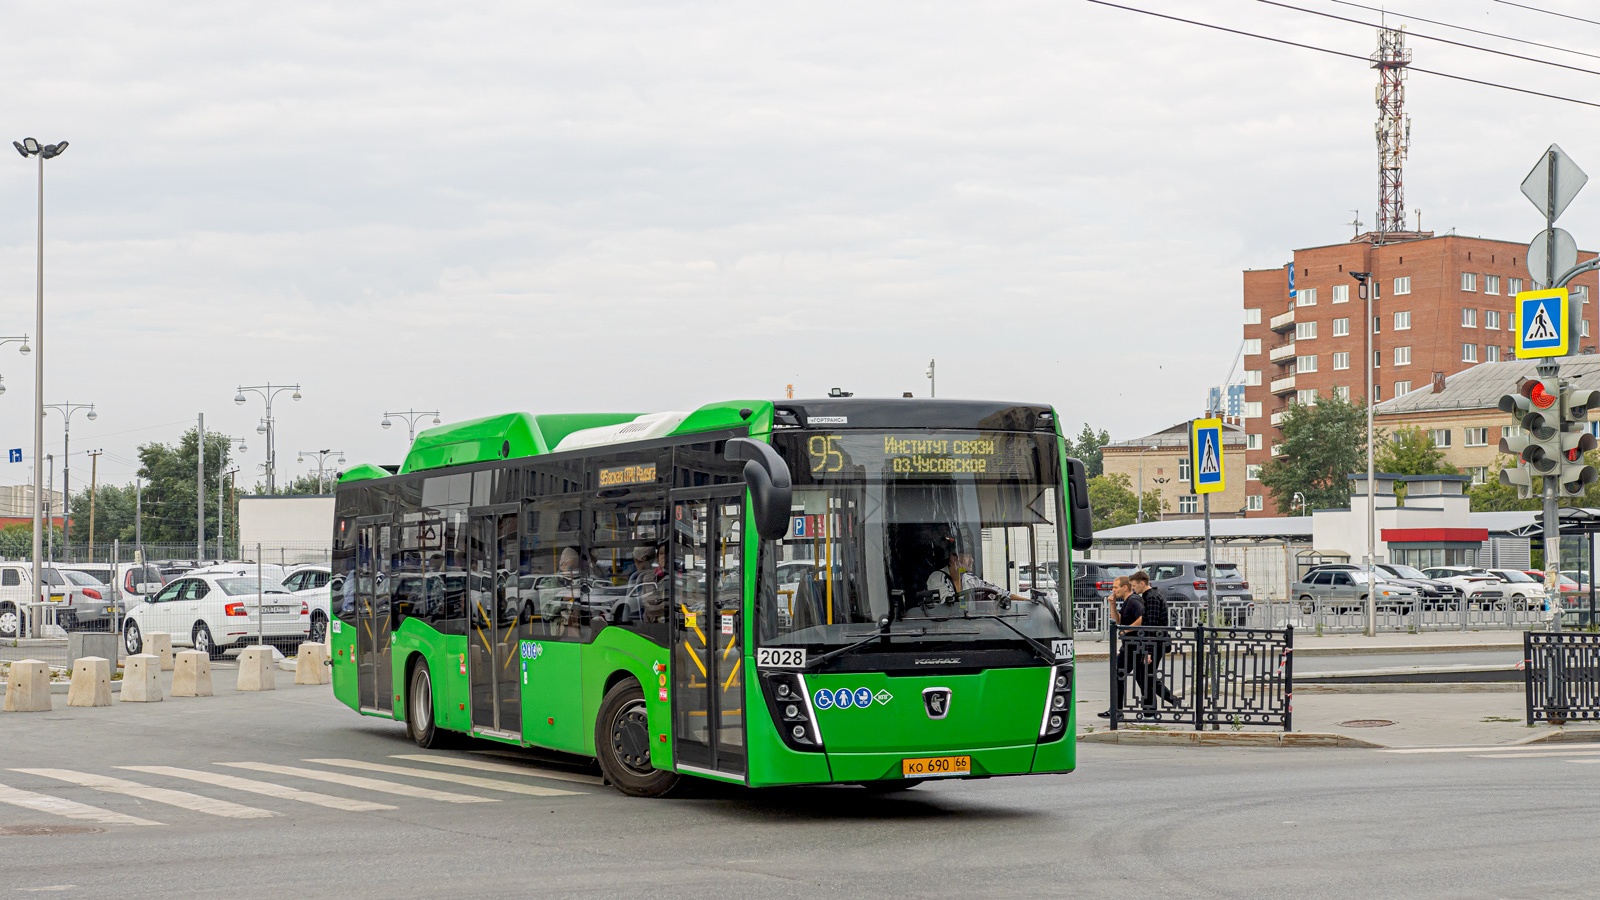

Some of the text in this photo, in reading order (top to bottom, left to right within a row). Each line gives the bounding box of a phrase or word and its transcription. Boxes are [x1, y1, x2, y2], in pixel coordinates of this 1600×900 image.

[808, 435, 843, 472] 95
[884, 436, 994, 455] Институт связи
[760, 650, 803, 666] 2028
[928, 759, 949, 771] 690
[955, 757, 967, 767] 66
